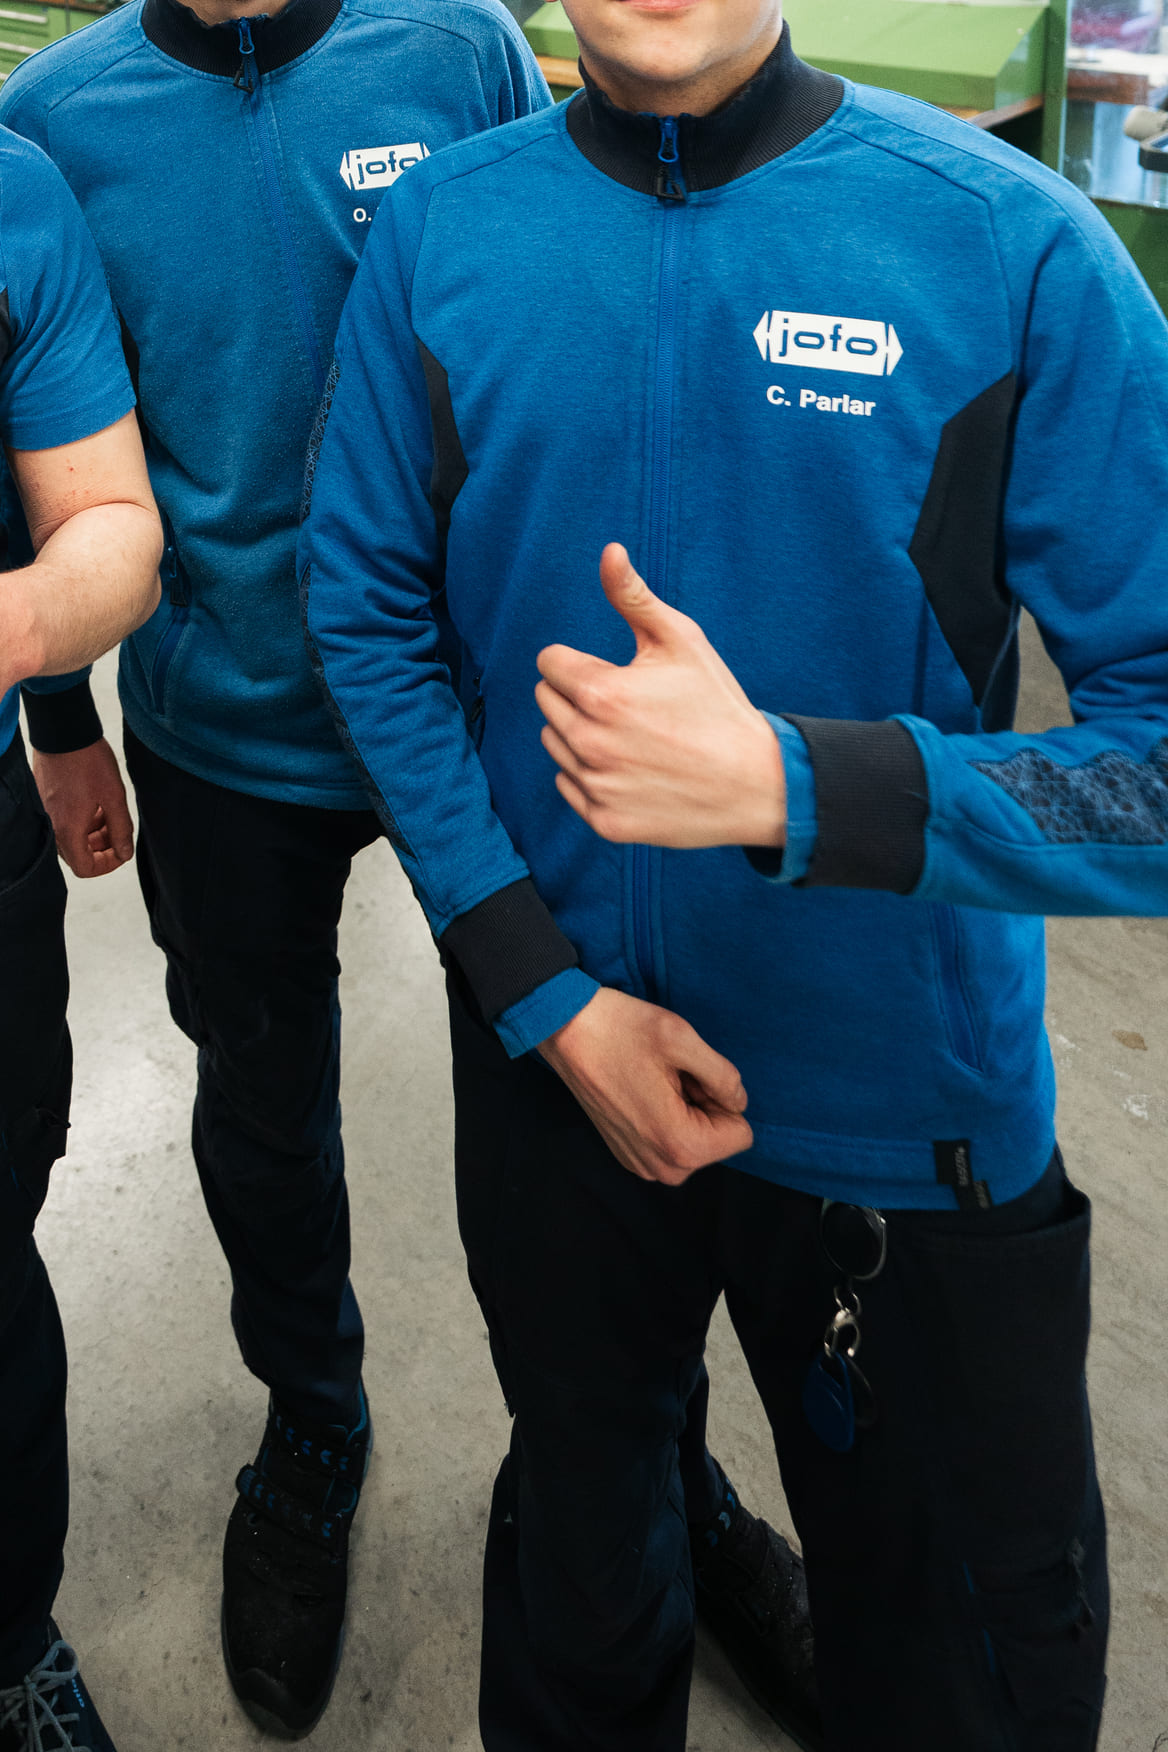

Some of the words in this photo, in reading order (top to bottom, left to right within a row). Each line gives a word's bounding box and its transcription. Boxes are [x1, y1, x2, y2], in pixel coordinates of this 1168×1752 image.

[353, 207, 372, 223] O.
[778, 318, 878, 358] jofo
[766, 385, 792, 407] C.
[799, 388, 876, 416] Parlar
